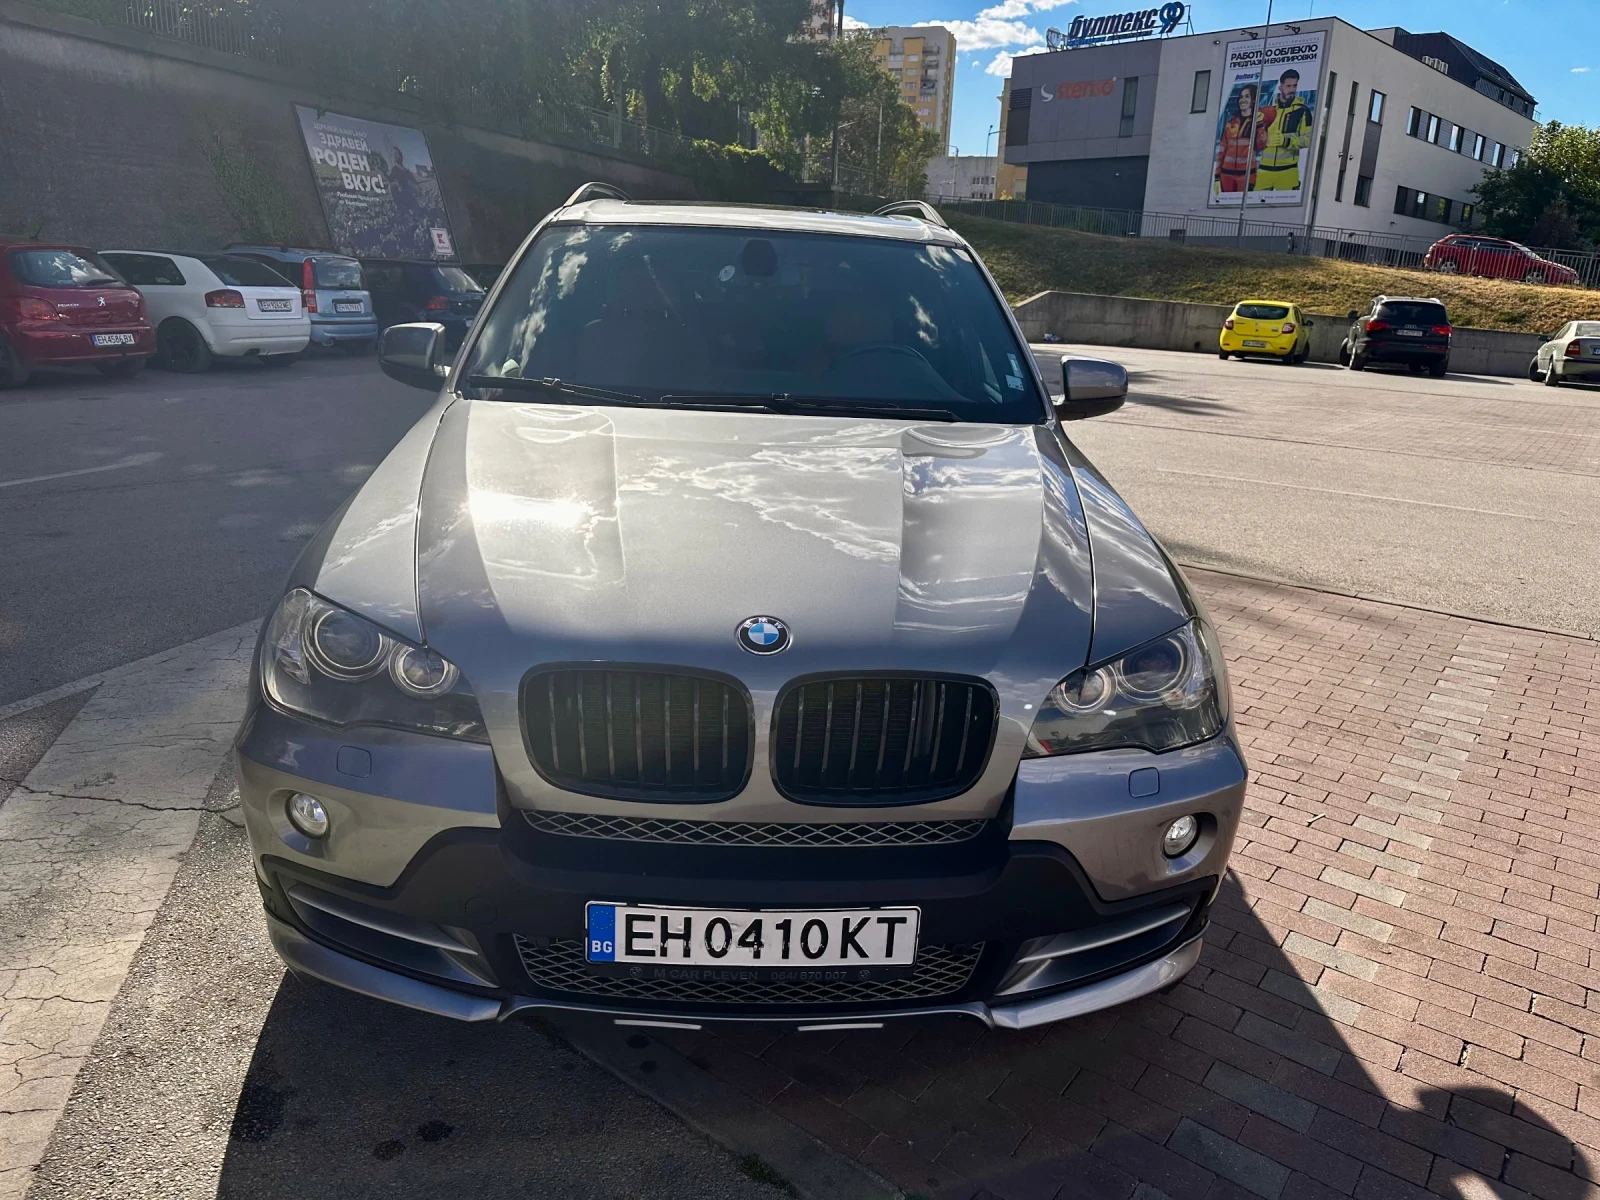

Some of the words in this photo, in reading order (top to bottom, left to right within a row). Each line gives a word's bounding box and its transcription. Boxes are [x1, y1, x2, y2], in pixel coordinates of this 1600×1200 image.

[1158, 1, 1185, 34] 99
[1273, 44, 1318, 57] ОБЛЕКЛО
[1230, 58, 1269, 68] ПРЕДПАЗИ
[1269, 53, 1317, 64] ЕКИПИРОВКИ
[1057, 79, 1114, 99] stenso
[318, 132, 371, 154] ЗДРАВЕЙ,
[312, 146, 371, 172] РОДЕН
[341, 172, 386, 194] ВКУС!
[743, 616, 783, 629] BMW
[591, 939, 613, 954] BG
[653, 968, 666, 979] M
[669, 969, 700, 980] CAR
[703, 970, 758, 981] PLEVEN
[799, 971, 824, 980] 870
[825, 970, 848, 980] 007
